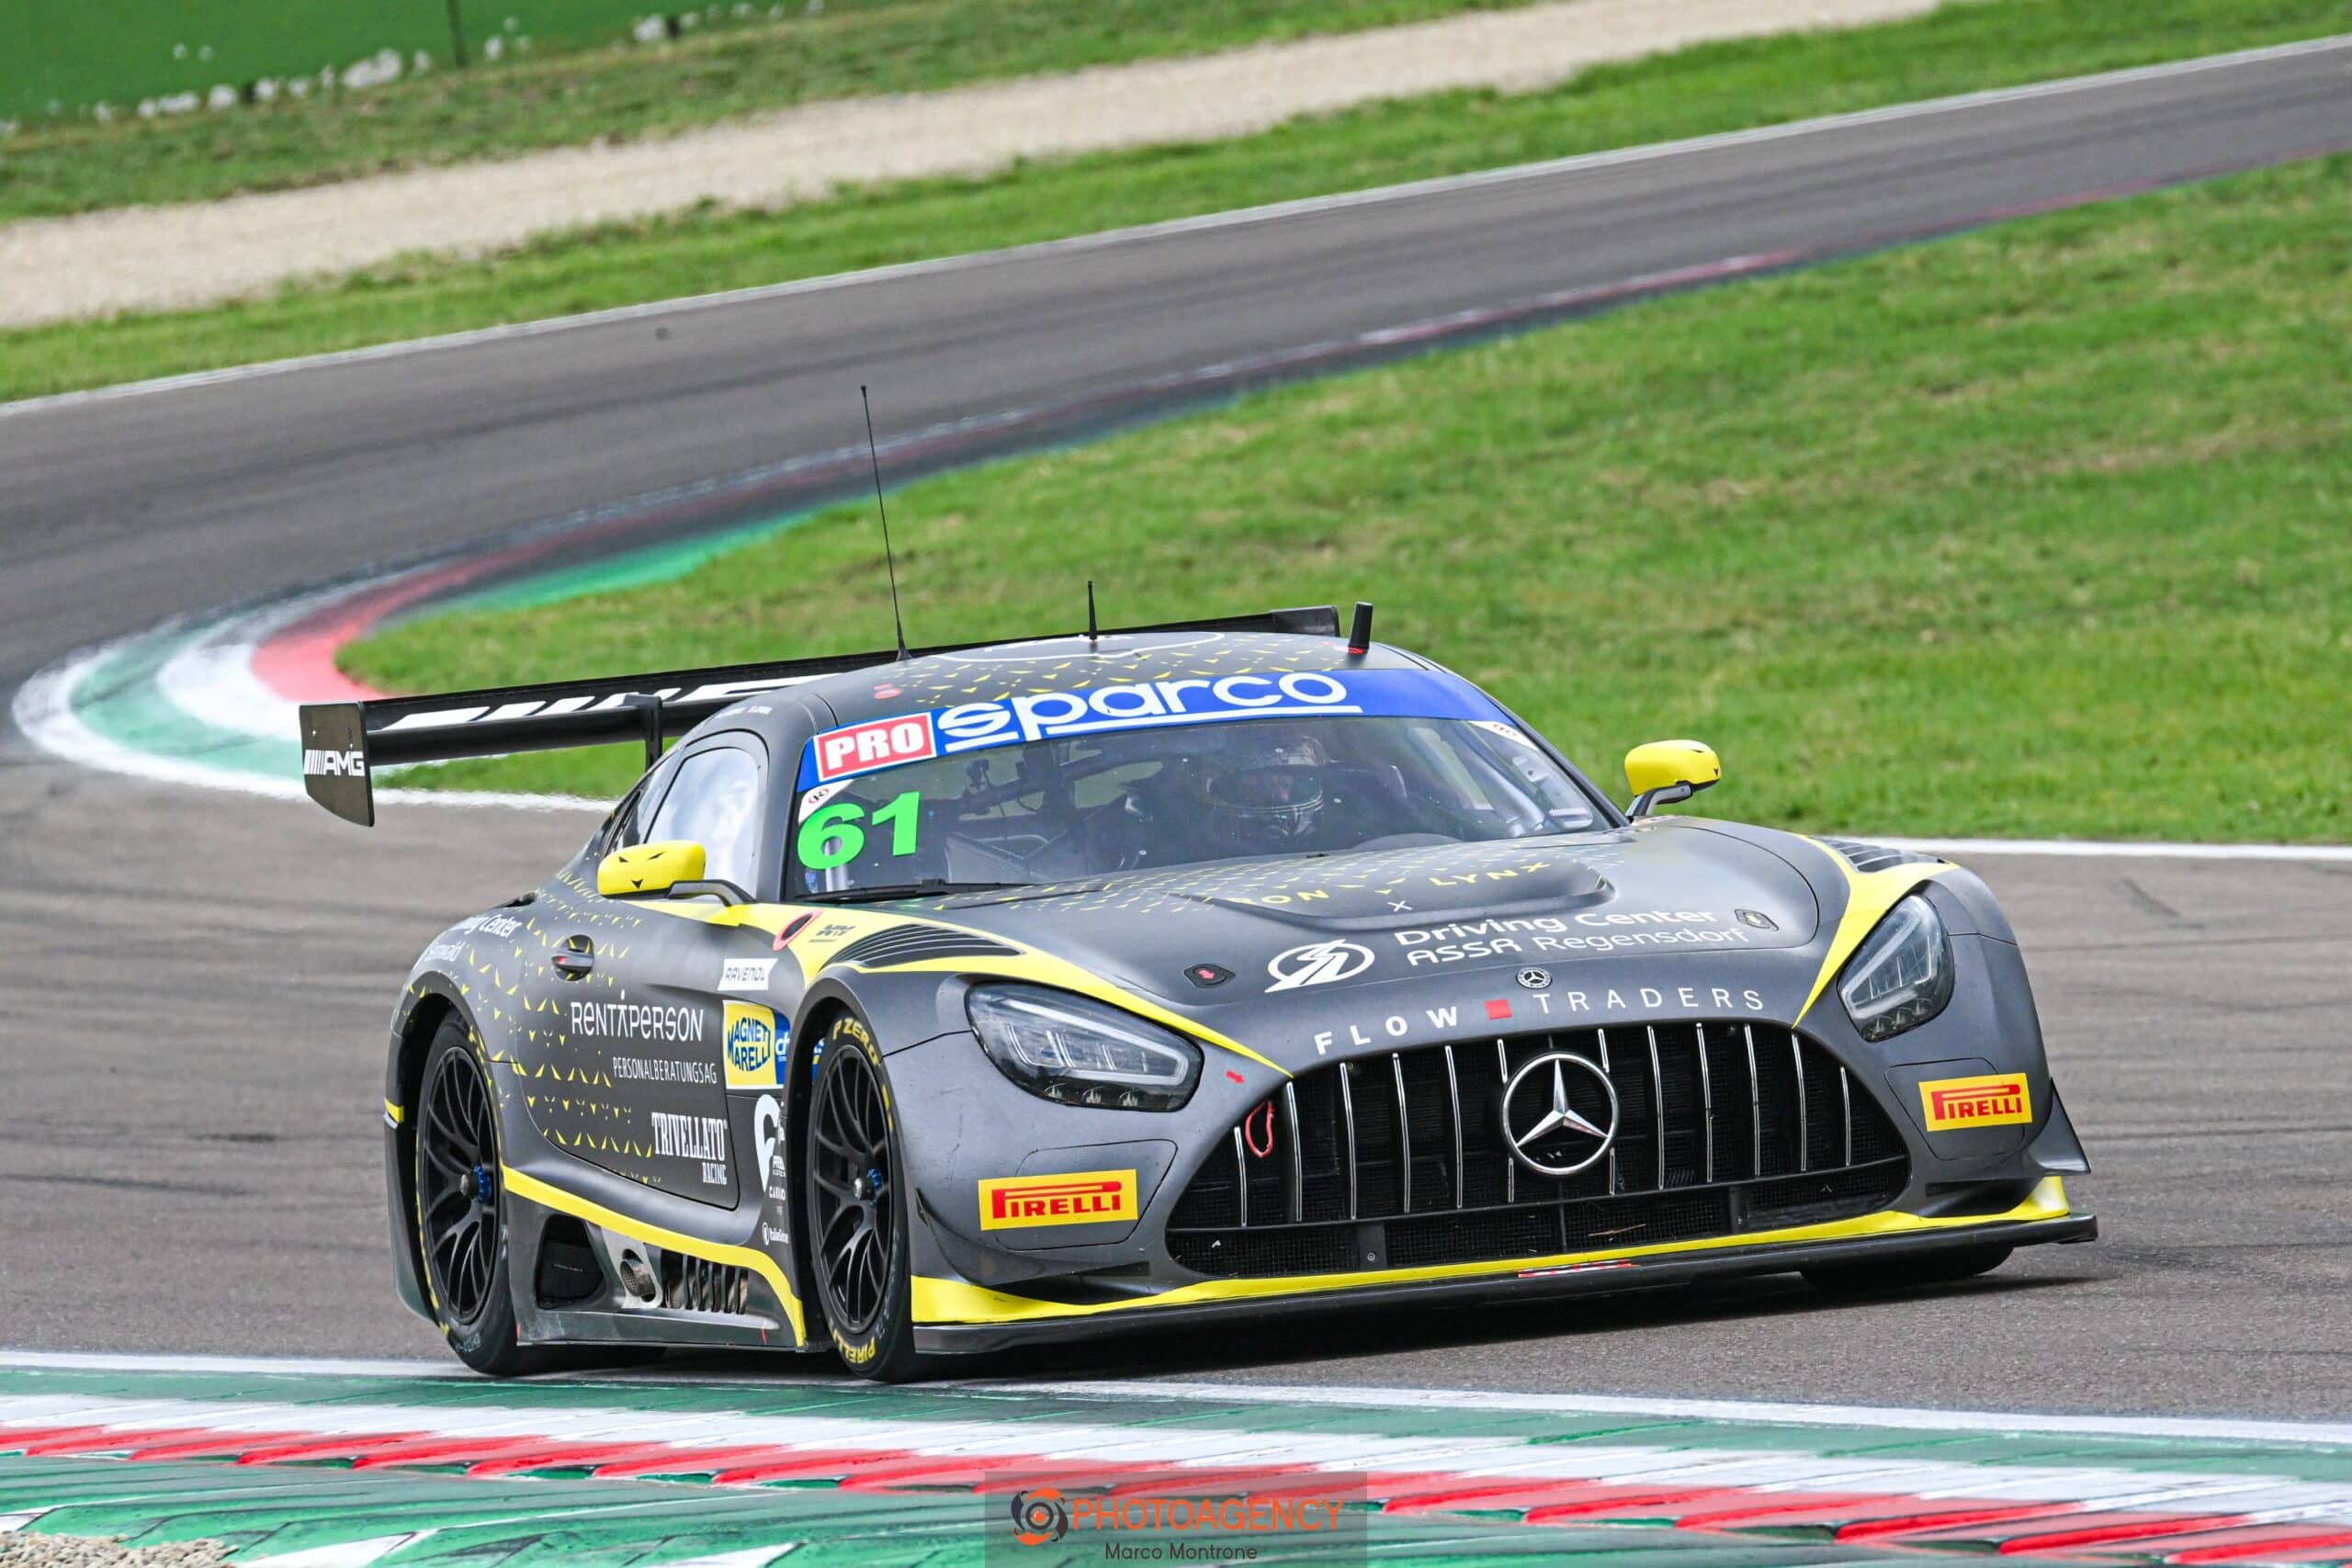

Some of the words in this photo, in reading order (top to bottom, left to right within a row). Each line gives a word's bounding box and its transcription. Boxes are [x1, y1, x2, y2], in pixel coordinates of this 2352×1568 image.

[937, 671, 1348, 741] sparco
[825, 722, 924, 771] PRO
[797, 791, 921, 871] 61
[1429, 862, 1552, 887] LYNX
[1395, 918, 1568, 946] Driving
[1575, 908, 1719, 929] Center
[1532, 926, 1751, 952] Regensdorf
[725, 966, 765, 982] RAVENOL
[1314, 1006, 1459, 1055] FLOW
[1532, 987, 1765, 1015] TRADERS
[1930, 1083, 2023, 1121] PIRELLI
[701, 1162, 728, 1185] RACING
[991, 1180, 1123, 1220] PIRELLI
